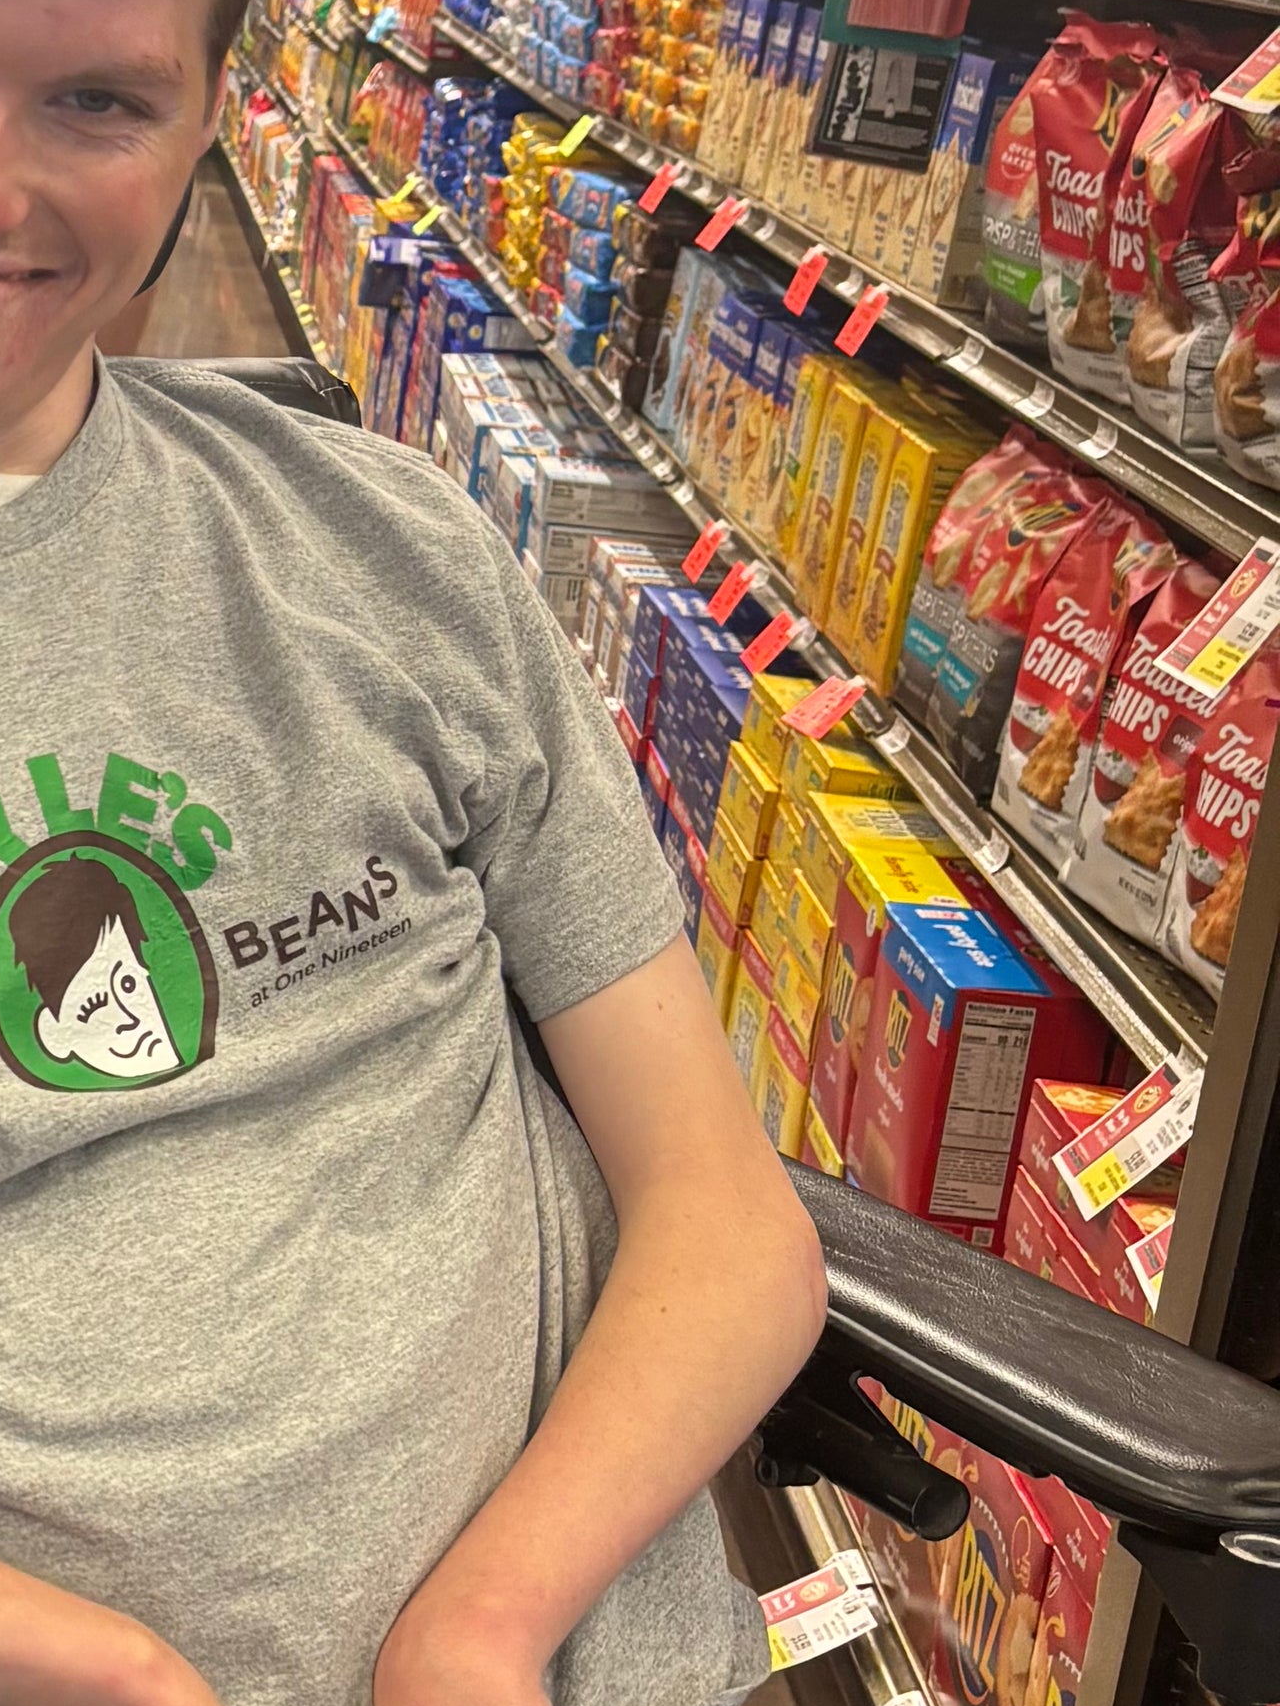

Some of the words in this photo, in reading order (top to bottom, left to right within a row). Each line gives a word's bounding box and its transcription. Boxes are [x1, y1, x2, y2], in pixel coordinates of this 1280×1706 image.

[1050, 195, 1098, 240] CHIPS
[1023, 636, 1088, 696] CHIPS
[221, 854, 400, 972] BEANS
[249, 987, 270, 1009] at
[274, 959, 316, 993] One
[320, 914, 414, 972] Nineteen
[953, 1519, 1007, 1693] RITZ
